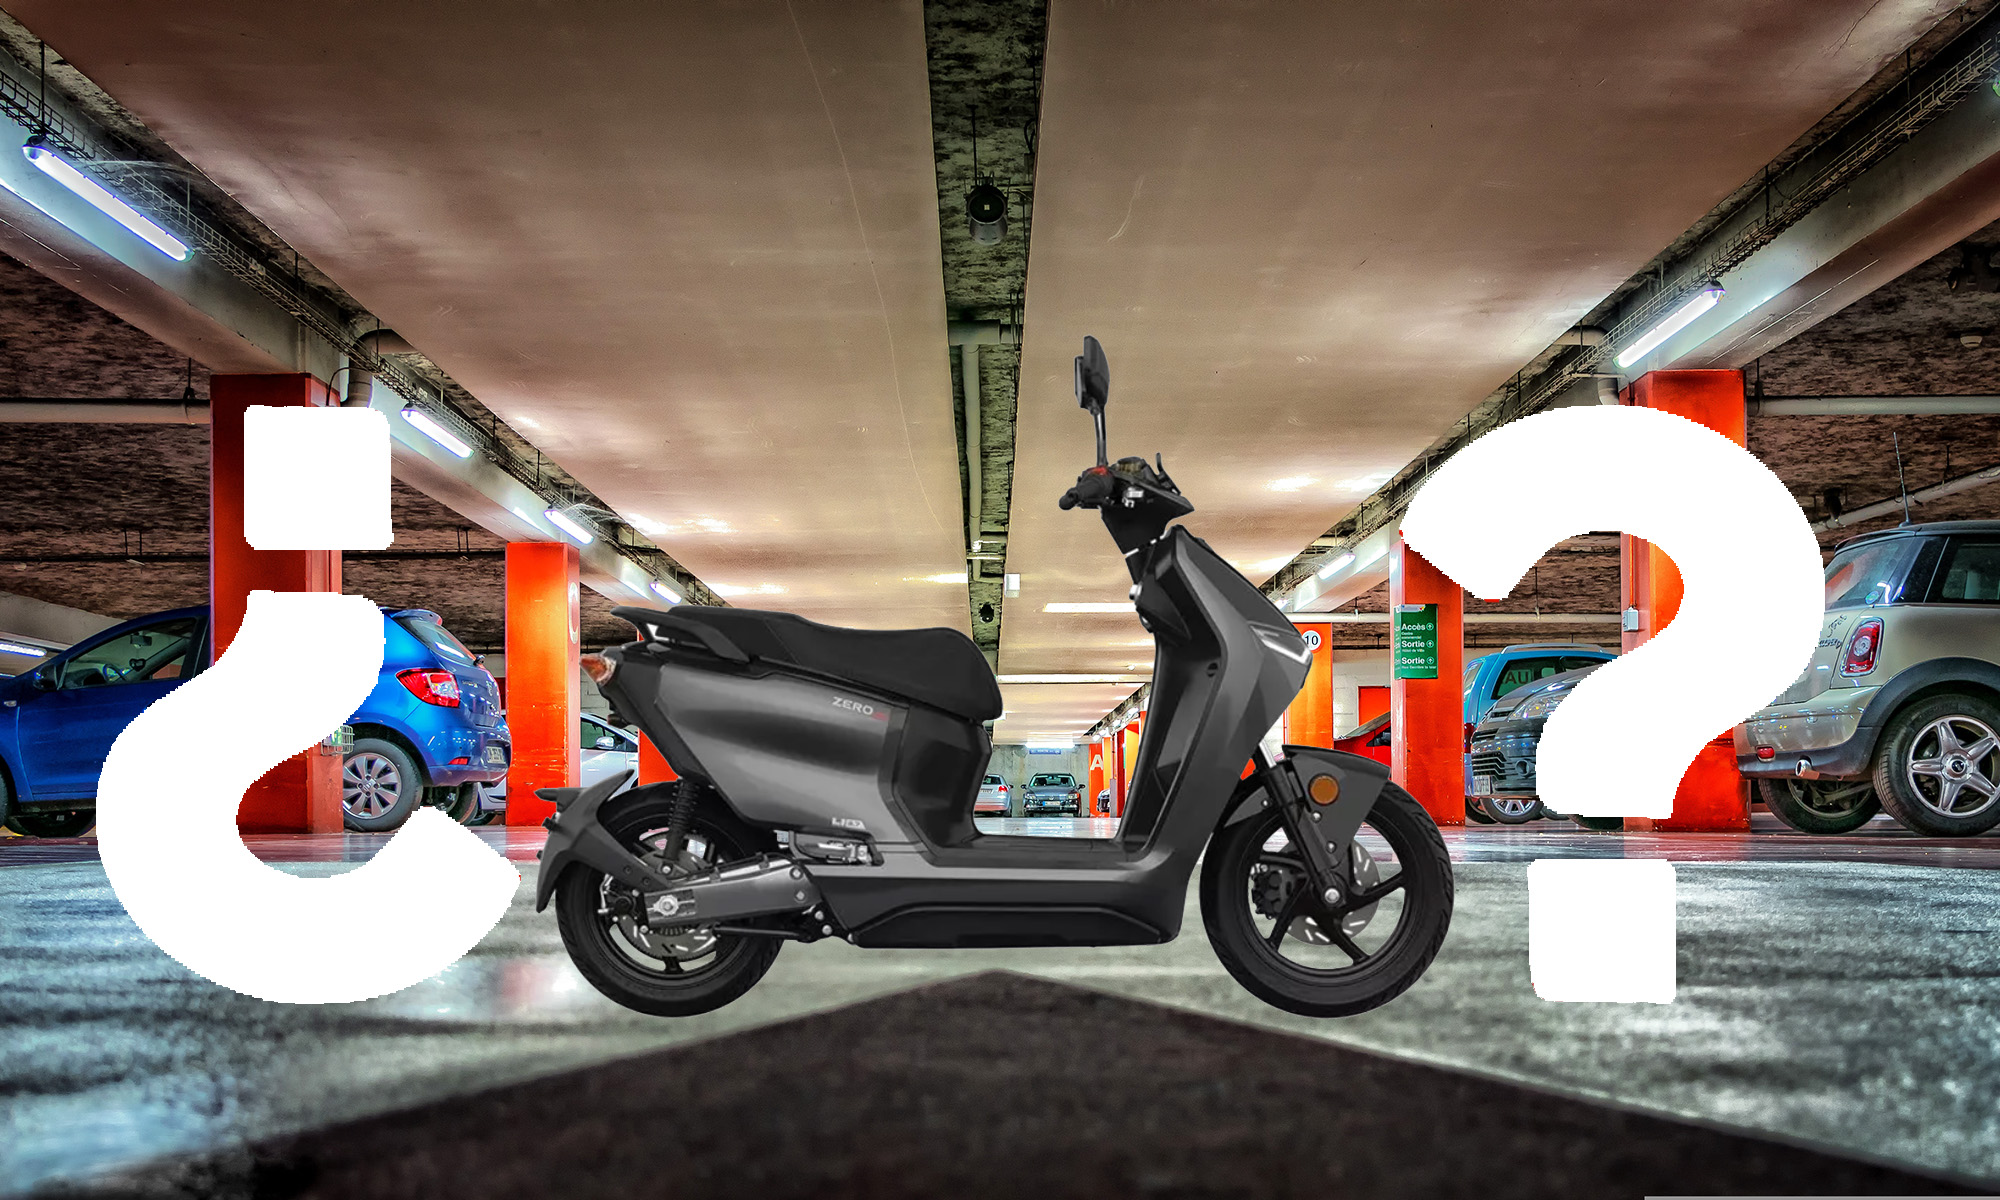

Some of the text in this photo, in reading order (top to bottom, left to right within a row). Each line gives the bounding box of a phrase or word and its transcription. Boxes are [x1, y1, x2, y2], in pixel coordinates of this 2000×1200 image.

[1401, 623, 1426, 631] Accès
[1304, 635, 1319, 646] 10
[1401, 640, 1425, 648] Sortie
[832, 696, 874, 716] ZERO
[1090, 754, 1103, 771] A
